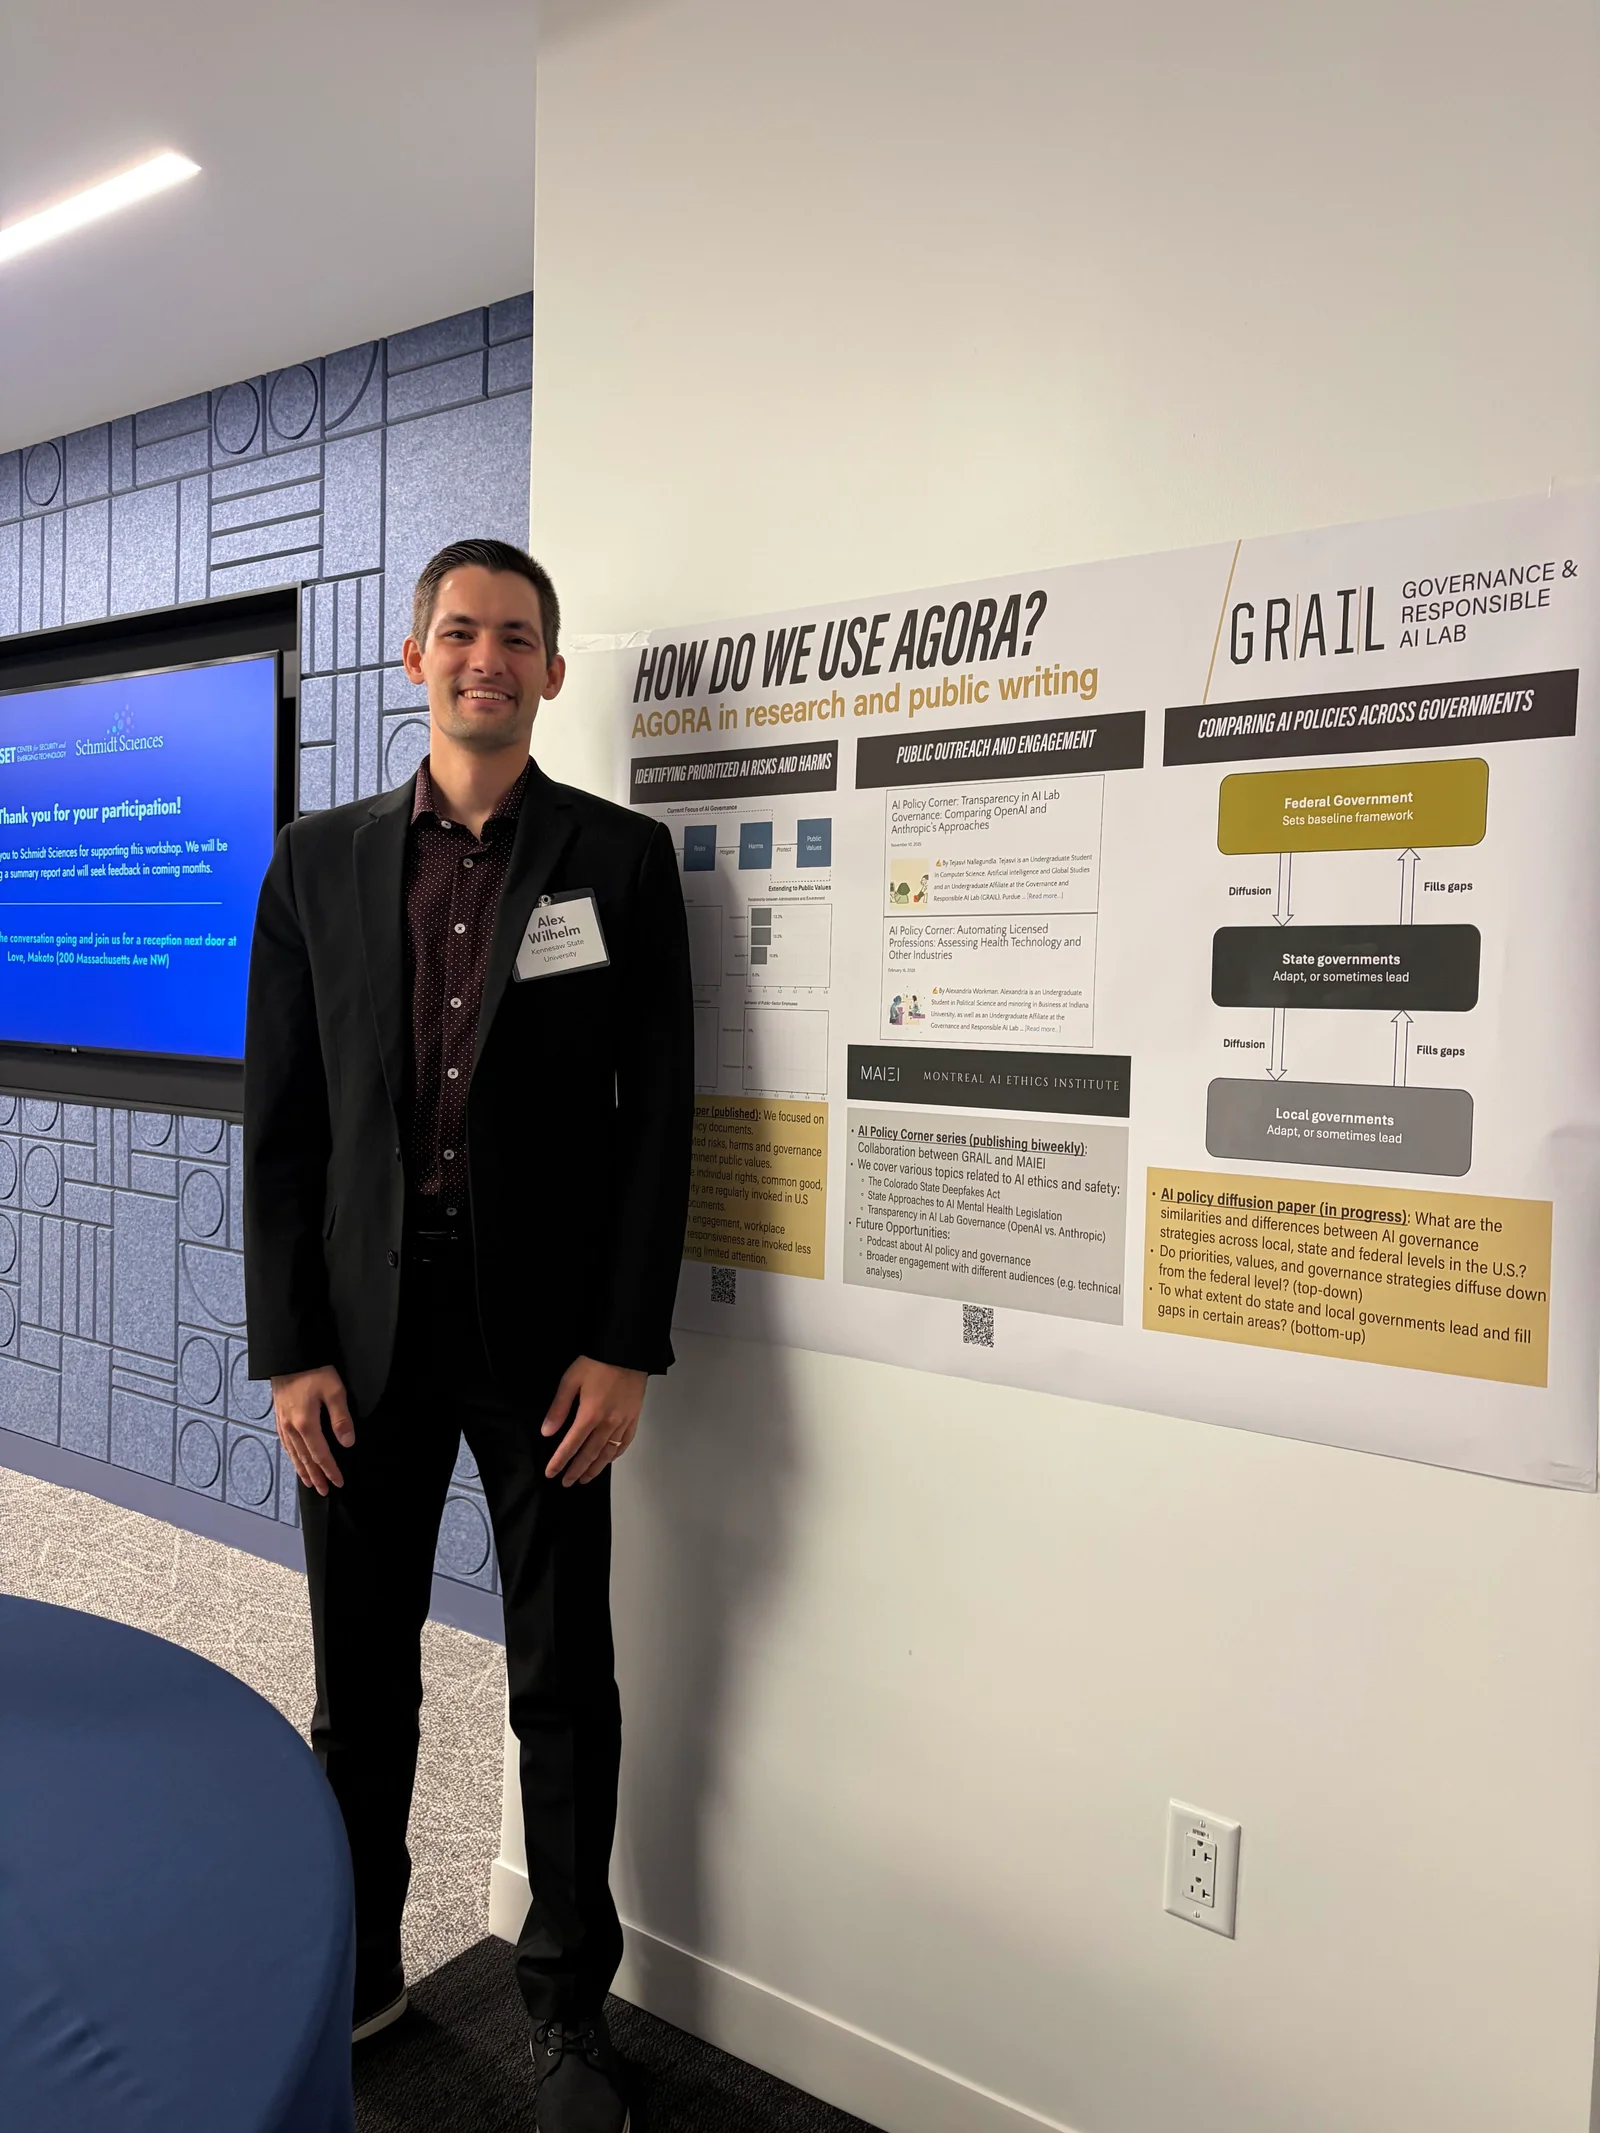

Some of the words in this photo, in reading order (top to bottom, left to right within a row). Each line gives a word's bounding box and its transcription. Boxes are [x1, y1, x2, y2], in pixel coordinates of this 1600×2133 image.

[1402, 562, 1555, 599] GOVERNANCE
[1561, 560, 1578, 578] &
[1401, 589, 1551, 624] RESPONSIBLE
[1230, 586, 1384, 665] GRAIL
[1400, 629, 1419, 648] AI
[1426, 624, 1466, 646] LAB
[632, 638, 712, 703] HOW
[708, 632, 756, 695] DO
[761, 624, 816, 689] WE
[818, 613, 891, 681] USE
[888, 589, 1048, 673] AGORA?
[632, 706, 712, 739] AGORA
[718, 702, 738, 731] in
[745, 689, 845, 727] research
[854, 683, 900, 717] and
[909, 675, 989, 718] public
[998, 665, 1099, 701] writing
[1198, 713, 1276, 738] COMPARING
[1277, 712, 1292, 730] AI
[1295, 706, 1356, 730] POLICIES
[1358, 700, 1415, 726] ACROSS
[1419, 690, 1534, 721] GOVERNMENTS
[76, 736, 117, 755] Schmidt
[120, 735, 163, 751] Sciences
[897, 743, 933, 765] PUBLIC
[934, 737, 991, 761] OUTREACH
[992, 735, 1016, 755] AND
[1018, 729, 1096, 754] ENGAGEMENT
[635, 766, 686, 784] IDENTIFYING
[687, 761, 739, 780] PRIORITIZED
[740, 759, 750, 776] AI
[751, 757, 777, 775] RISKS
[778, 756, 798, 773] AND
[798, 753, 832, 772] HARMS
[892, 800, 900, 809] AI
[903, 799, 926, 811] Policy
[929, 798, 959, 808] Corner:
[962, 794, 1019, 808] Transparency
[1022, 792, 1029, 801] in
[1032, 791, 1041, 800] AI
[1044, 789, 1060, 800] Lab
[1284, 796, 1331, 809] Federal
[1334, 792, 1413, 806] Government
[31, 811, 50, 827] you
[54, 803, 70, 821] for
[74, 807, 98, 825] your
[102, 797, 181, 823] participation!
[892, 811, 942, 822] Governance:
[945, 808, 992, 821] Comparing
[994, 805, 1027, 817] OpenAI
[1030, 804, 1047, 814] and
[1282, 815, 1305, 826] Sets
[1308, 812, 1352, 824] baseline
[1356, 810, 1413, 822] framework
[938, 821, 989, 835] Approaches
[12, 850, 18, 860] to
[20, 848, 46, 859] Schmidt
[48, 847, 77, 858] Sciences
[79, 845, 88, 857] for
[91, 843, 128, 858] supporting
[130, 843, 144, 855] this
[146, 842, 183, 855] workshop.
[186, 841, 199, 852] We
[201, 839, 214, 851] will
[217, 839, 228, 851] be
[1229, 886, 1272, 896] Diffusion
[1424, 882, 1445, 891] Fills
[1448, 882, 1472, 893] gaps
[538, 915, 565, 928] Alex
[528, 926, 580, 943] Wilhelm
[889, 926, 898, 935] AI
[900, 925, 923, 940] Policy
[925, 925, 955, 935] Corner:
[958, 925, 1006, 936] Automating
[1009, 924, 1048, 934] Licensed
[531, 943, 565, 955] Kennesaw
[567, 939, 584, 947] State
[889, 950, 911, 960] Other
[914, 950, 952, 959] Industries
[8, 952, 25, 963] Love,
[28, 952, 54, 963] Makoto
[56, 953, 74, 965] (200
[77, 953, 130, 965] Massachusetts
[133, 955, 147, 965] Ave
[150, 955, 169, 968] NW)
[544, 951, 577, 962] University
[1283, 953, 1315, 965] State
[1317, 954, 1400, 967] governments
[1273, 971, 1307, 982] Adapt,
[1310, 973, 1321, 981] or
[1323, 972, 1383, 982] sometimes
[1386, 972, 1409, 982] lead
[1223, 1039, 1265, 1049] Diffusion
[1417, 1045, 1438, 1056] Fills
[1441, 1046, 1465, 1058] gaps
[923, 1072, 984, 1084] MONTREAL
[989, 1075, 1001, 1084] AI
[1007, 1076, 1049, 1087] ETHICS
[1054, 1078, 1119, 1091] INSTITUTE
[712, 1108, 761, 1121] (published):
[764, 1111, 777, 1120] We
[779, 1111, 811, 1124] focused
[813, 1116, 824, 1124] on
[1276, 1108, 1309, 1121] Local
[1312, 1111, 1394, 1126] governments
[858, 1126, 868, 1137] AI
[870, 1127, 898, 1141] Policy
[900, 1129, 933, 1142] Corner
[937, 1132, 966, 1145] series
[969, 1133, 1028, 1151] (publishing
[1032, 1138, 1087, 1156] biweekly):
[1267, 1125, 1301, 1138] Adapt,
[1303, 1129, 1314, 1137] or
[1317, 1128, 1376, 1142] sometimes
[1378, 1132, 1402, 1143] lead
[858, 1142, 915, 1158] Collaboration
[918, 1149, 958, 1162] between
[962, 1151, 992, 1165] GRAIL
[995, 1154, 1013, 1167] and
[1016, 1156, 1046, 1170] MAIEI
[869, 1176, 881, 1187] The
[884, 1178, 918, 1191] Colorado
[920, 1181, 940, 1193] State
[942, 1183, 984, 1198] Deepfakes
[987, 1189, 1000, 1199] Act
[1161, 1188, 1173, 1200] AI
[1177, 1190, 1214, 1206] policy
[1217, 1193, 1273, 1209] diffusion
[1277, 1199, 1315, 1214] paper
[1319, 1202, 1336, 1217] (in
[1341, 1206, 1411, 1225] progress):
[1415, 1212, 1450, 1228] What
[1454, 1219, 1476, 1229] are
[1480, 1218, 1502, 1232] the
[1161, 1208, 1221, 1224] similarities
[1225, 1215, 1248, 1227] and
[1252, 1216, 1319, 1234] differences
[1323, 1223, 1378, 1240] between
[1382, 1230, 1395, 1243] AI
[1399, 1232, 1479, 1251] governance
[1159, 1264, 1184, 1278] from
[1189, 1268, 1206, 1281] the
[1210, 1270, 1250, 1287] federal
[1254, 1275, 1289, 1291] level?
[1293, 1280, 1363, 1303] (top-down)
